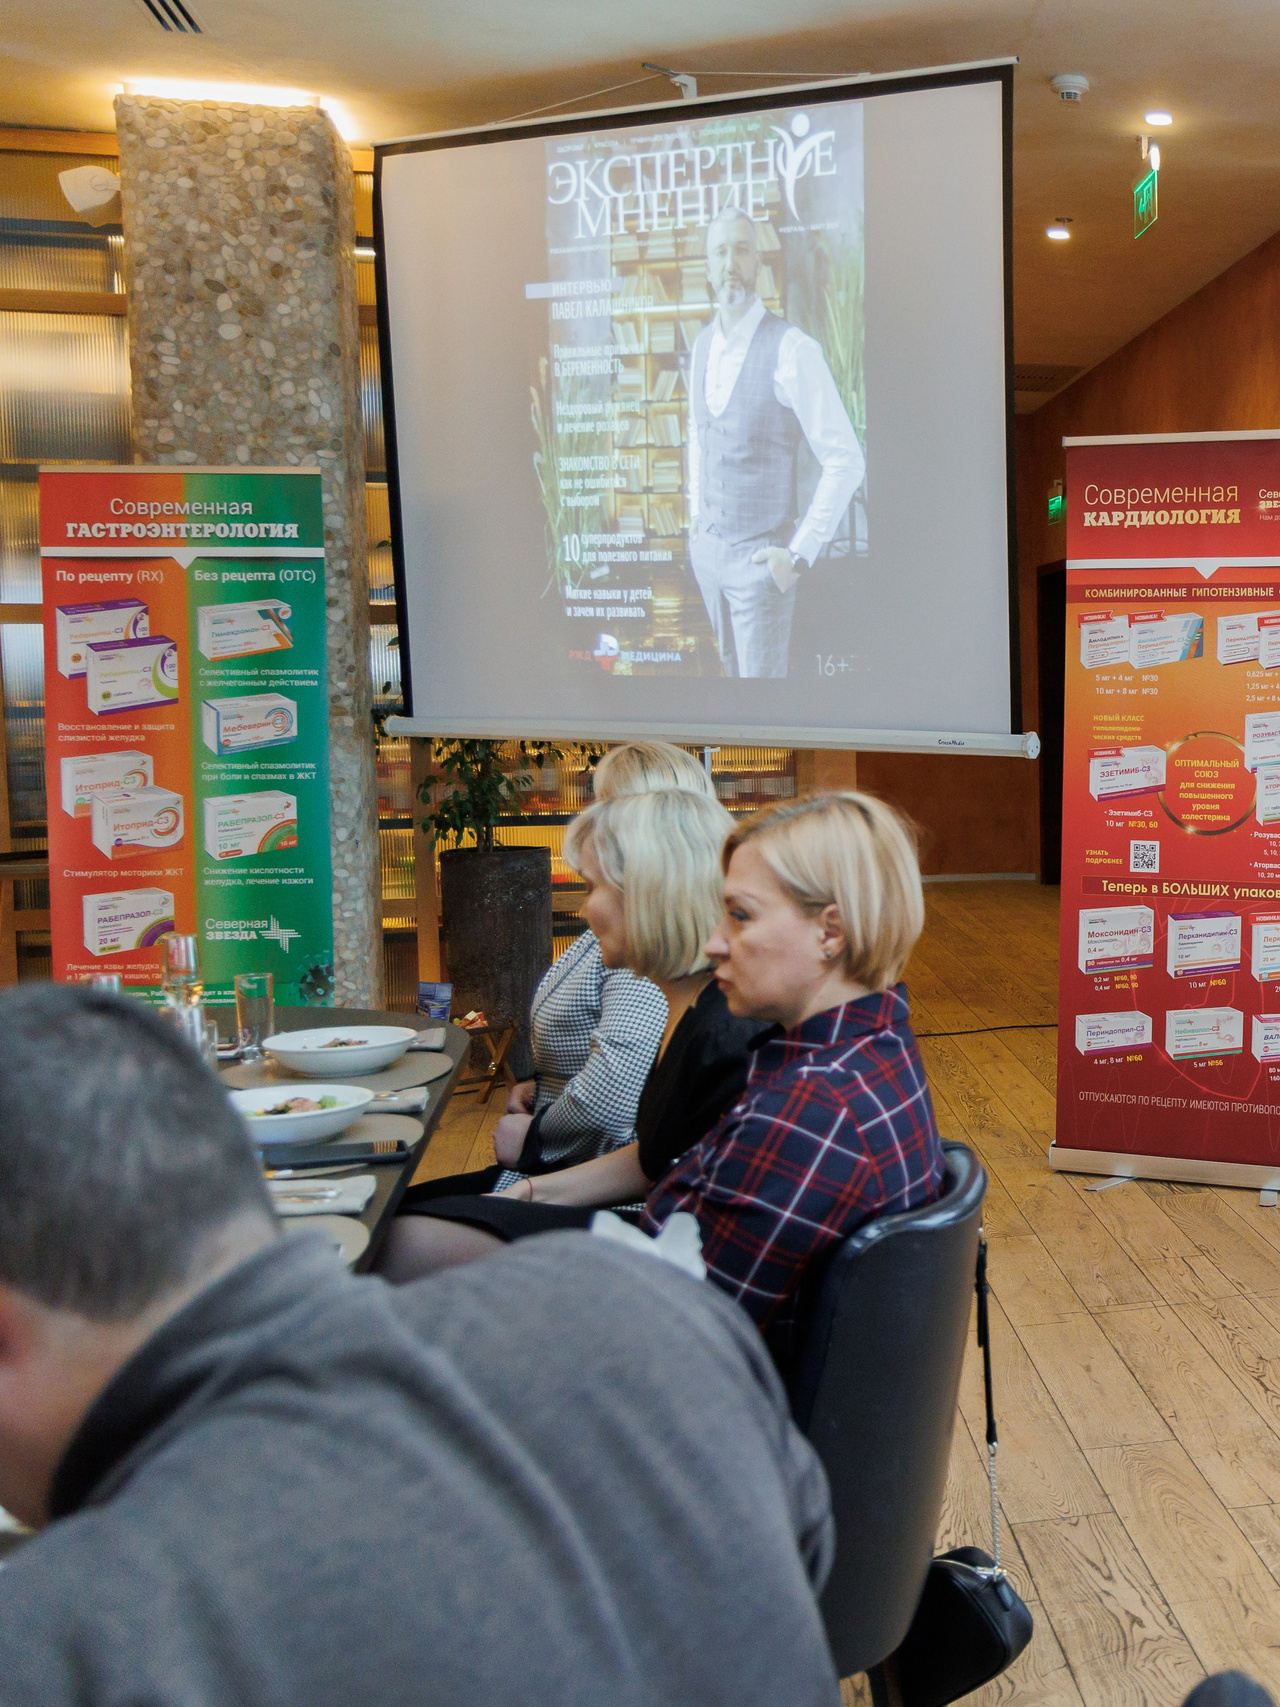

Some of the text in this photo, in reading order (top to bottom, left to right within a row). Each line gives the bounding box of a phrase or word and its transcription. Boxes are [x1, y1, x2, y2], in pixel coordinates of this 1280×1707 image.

[548, 130, 837, 204] ЭКСПЕРТНОЕ
[574, 181, 770, 239] МНЕНИЕ
[552, 279, 612, 296] ИНТЕРВЬЮ
[552, 301, 583, 320] ПАВЕЛ
[554, 344, 602, 362] Правильные
[561, 358, 625, 377] БЕРЕМЕННОСТЬ
[556, 401, 641, 417] Нездоровый румянец
[565, 422, 595, 433] лечение
[559, 456, 610, 471] ЗНАКОМСТВО
[560, 478, 572, 489] как
[575, 478, 583, 489] не
[567, 491, 599, 509] выбором
[1084, 484, 1238, 509] Современная
[110, 498, 253, 518] Современная
[1083, 509, 1241, 528] КАРДИОЛОГИЯ
[1259, 513, 1272, 521] Нам
[66, 522, 299, 539] ГАСТРОЭНТЕРОЛОГИЯ
[563, 533, 581, 562] 10
[582, 534, 643, 548] суперпродуктов
[582, 550, 673, 564] для полезного питания
[56, 571, 164, 584] По рецепту (RX)
[194, 570, 218, 581] Без
[222, 571, 276, 584] рецепта
[565, 585, 592, 600] Мягкие
[593, 589, 621, 600] навыки
[1085, 588, 1187, 598] КОМБИНИРОВАННЫЕ
[1191, 587, 1274, 597] ГИПОТЕНЗИВНЫЕ
[573, 607, 594, 617] зачем
[596, 607, 605, 617] их
[607, 606, 646, 620] развивать
[568, 650, 682, 663] РЖД МЕДИЦИНА
[816, 654, 849, 676] 16+
[199, 668, 259, 676] Селективный
[268, 679, 318, 687] действием
[1093, 714, 1120, 722] НОВЫЙ
[58, 723, 132, 731] Восстановление
[58, 734, 146, 742] слизистой желудка
[202, 762, 259, 770] Селективный
[1174, 759, 1240, 768] ОПТИМАЛЬНЫЙ
[297, 772, 316, 780] ЖКТ
[1194, 770, 1219, 778] СОЮЗ
[1179, 782, 1195, 790] для
[1181, 814, 1231, 822] холестерина
[63, 868, 184, 878] Стимулятор моторики ЖКТ
[203, 867, 248, 875] Снижение
[204, 878, 244, 887] желудка,
[1102, 880, 1148, 895] Теперь
[1151, 884, 1158, 893] в
[1162, 882, 1229, 896] БОЛЬШИХ
[205, 918, 268, 930] Северная
[206, 931, 258, 941] ЗВЕЗДА
[66, 963, 101, 971] Лечение
[126, 963, 159, 971] желудка
[1079, 1091, 1136, 1105] ОТПУСКАЮТСЯ
[1138, 1096, 1149, 1105] ПО
[1151, 1097, 1188, 1108] РЕЦЕПТУ.
[1189, 1100, 1229, 1111] ИМЕЮТСЯ
